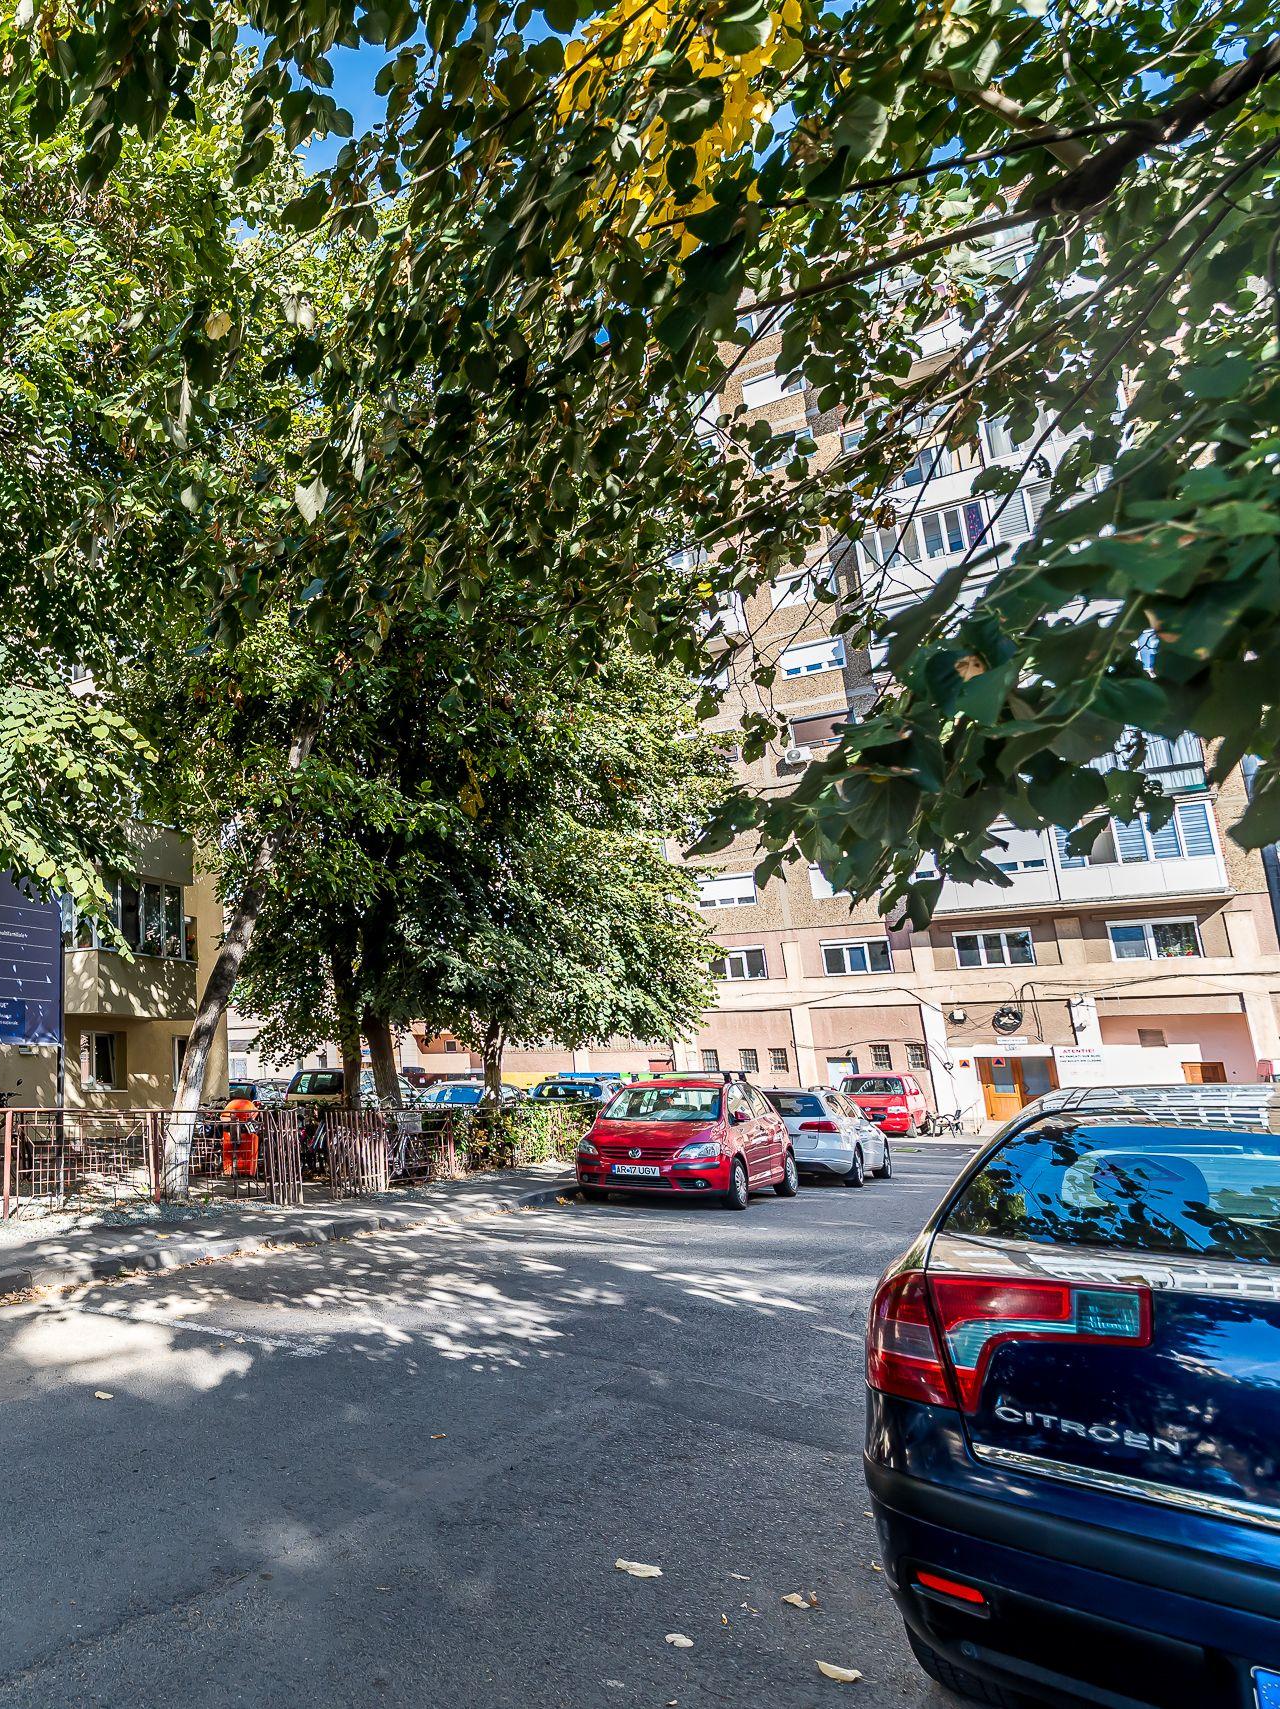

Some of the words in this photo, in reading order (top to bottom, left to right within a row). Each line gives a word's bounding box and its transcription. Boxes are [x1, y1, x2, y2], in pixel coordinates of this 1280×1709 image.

[617, 1165, 626, 1173] AR
[630, 1166, 637, 1174] 17
[638, 1167, 656, 1175] UGV
[995, 1406, 1181, 1456] CITROËN
